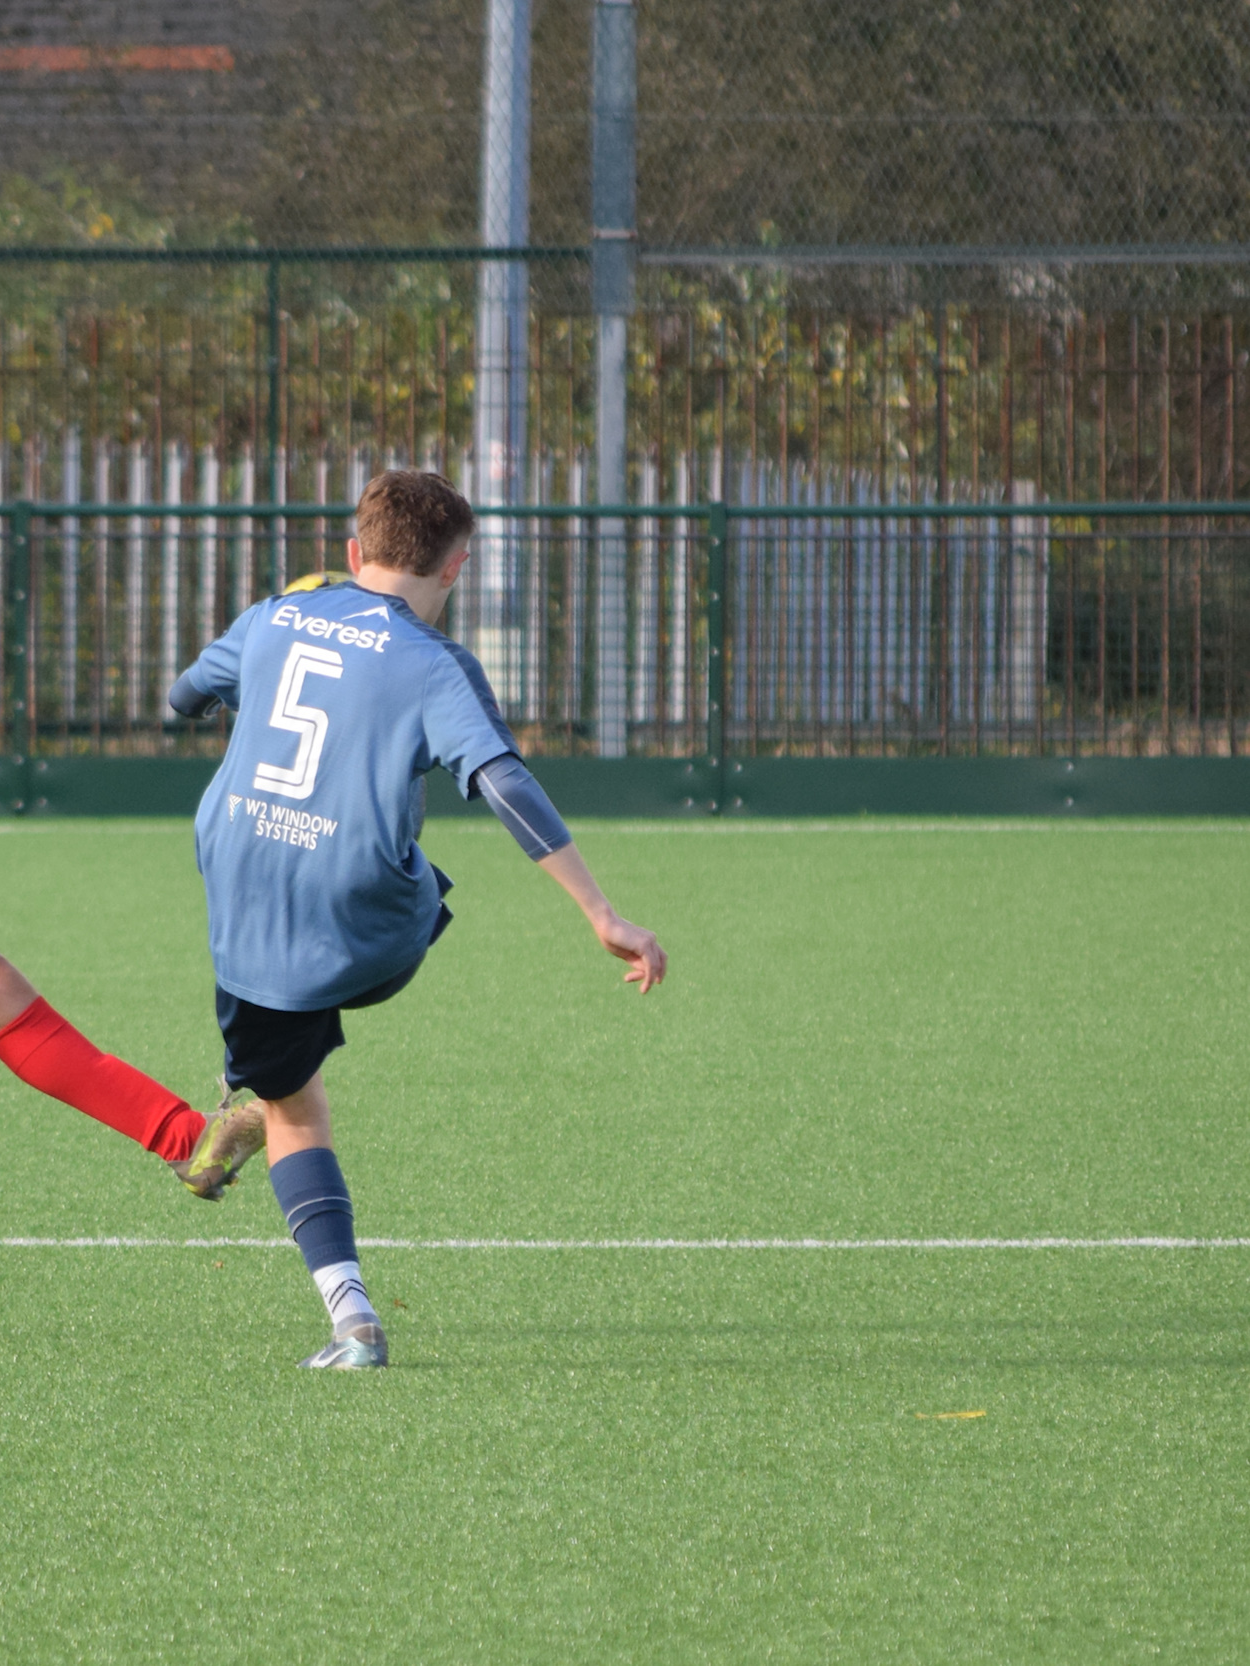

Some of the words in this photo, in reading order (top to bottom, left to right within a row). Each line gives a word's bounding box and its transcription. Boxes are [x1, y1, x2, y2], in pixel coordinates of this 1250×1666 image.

[271, 605, 391, 653] Everest
[254, 642, 343, 800] 5
[246, 799, 267, 819] W2
[271, 804, 338, 837] WINDOW
[255, 819, 318, 850] SYSTEMS
